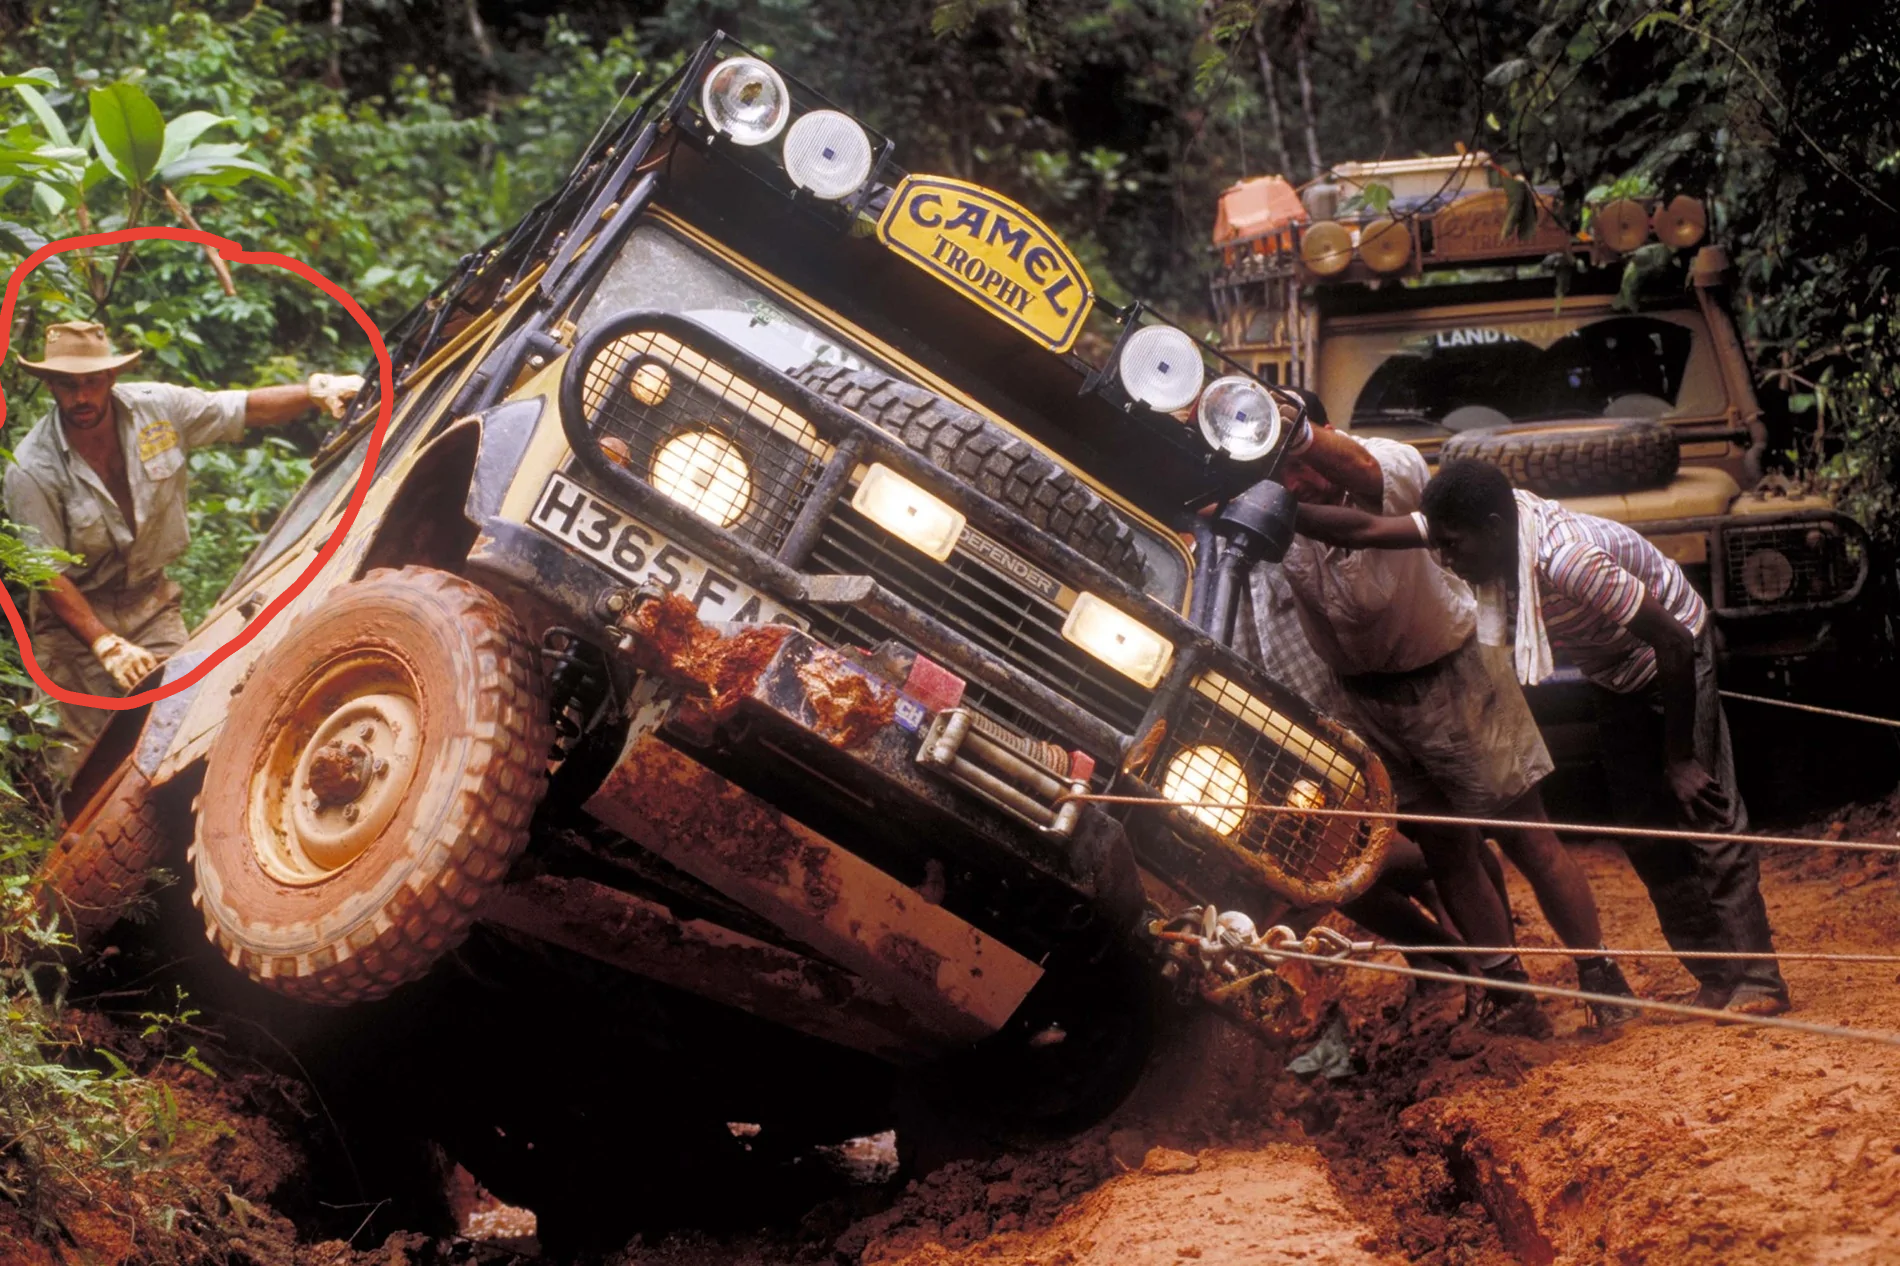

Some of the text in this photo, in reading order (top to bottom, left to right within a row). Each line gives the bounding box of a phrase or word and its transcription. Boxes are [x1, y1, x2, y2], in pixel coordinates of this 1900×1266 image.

[908, 193, 1074, 317] CAMEL
[931, 234, 1037, 315] TROPHY
[1436, 327, 1500, 348] LAND
[538, 480, 690, 592] H365
[959, 527, 1054, 595] DEFENDER
